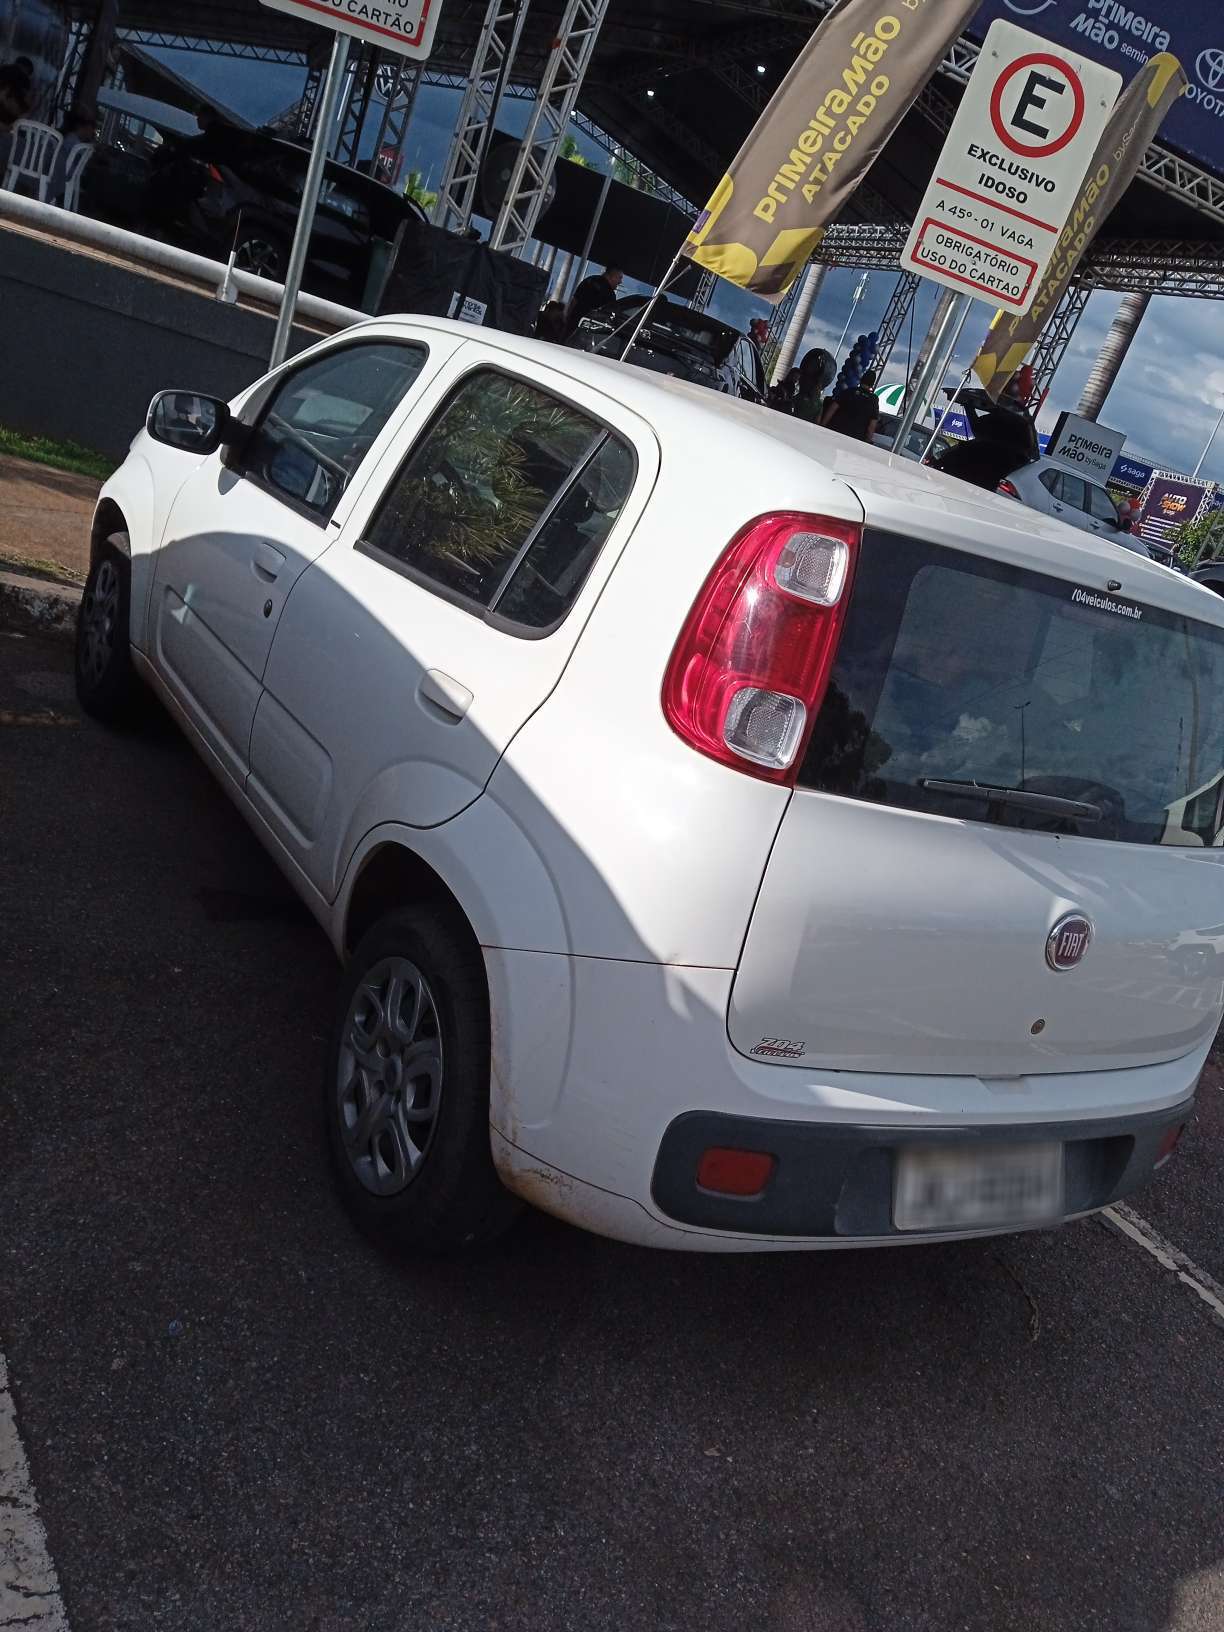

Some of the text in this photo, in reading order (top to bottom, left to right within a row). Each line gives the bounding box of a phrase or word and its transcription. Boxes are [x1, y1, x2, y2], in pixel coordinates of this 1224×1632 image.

[347, 0, 414, 34] CARTÃO
[1120, 43, 1149, 64] semin
[1010, 69, 1066, 140] E
[1185, 83, 1224, 117] OYOT
[801, 75, 890, 204] ATACADO
[967, 143, 1056, 193] EXCLUSIVO
[978, 173, 1028, 204] IDOSO
[936, 200, 945, 211] A
[980, 218, 995, 232] 01
[1000, 226, 1034, 249] VAGA
[921, 247, 947, 266] USO
[949, 259, 967, 274] DO
[936, 233, 1019, 276] OBRIGATÓRIO
[1031, 215, 1097, 321] ATACADO
[1127, 466, 1145, 479] saga
[1058, 932, 1085, 957] FIAT
